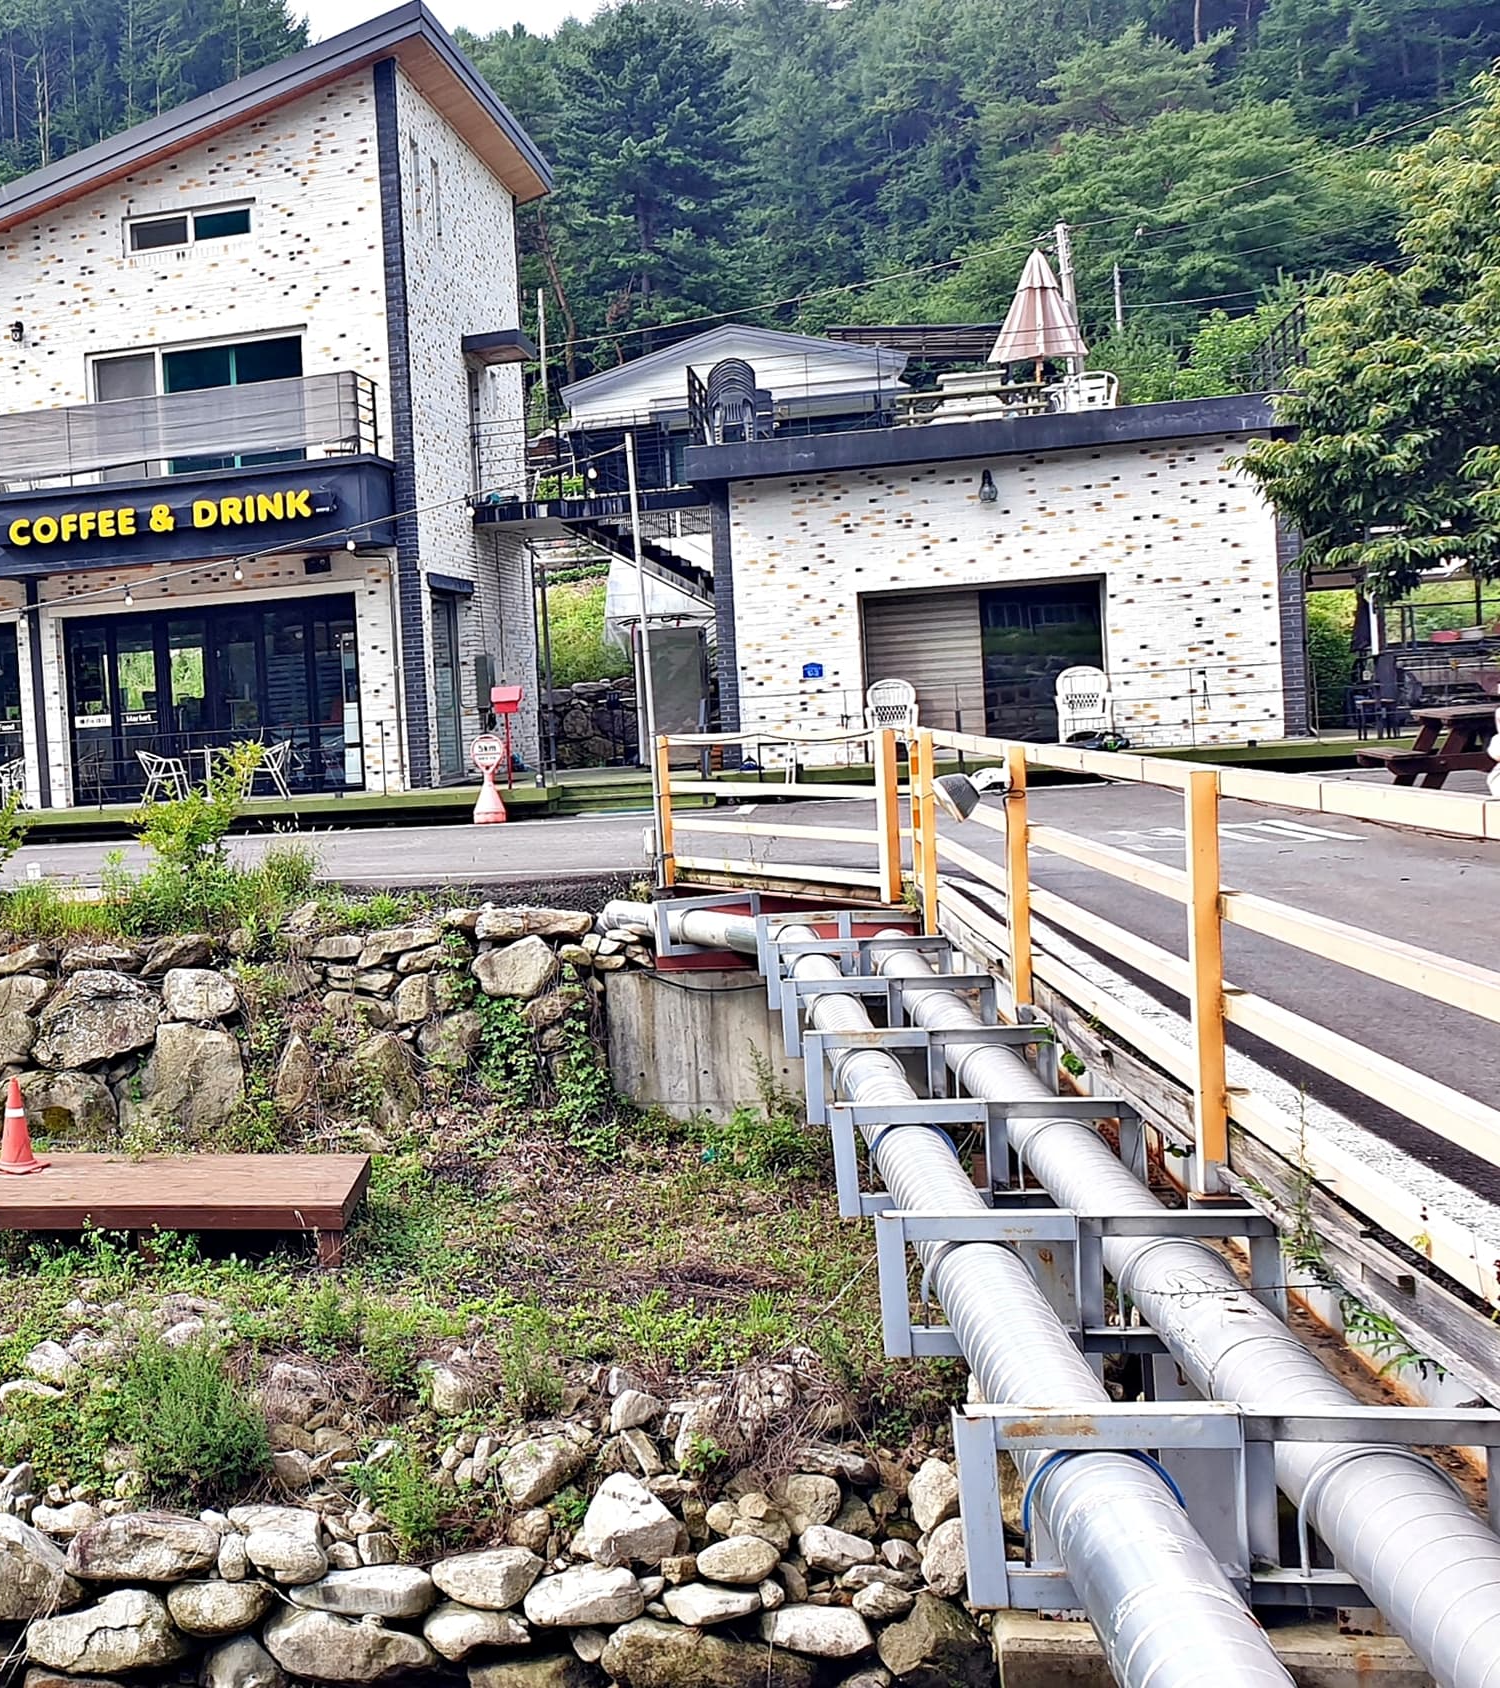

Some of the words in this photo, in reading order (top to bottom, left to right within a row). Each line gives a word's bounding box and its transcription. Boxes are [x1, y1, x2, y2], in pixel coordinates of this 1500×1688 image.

[8, 507, 137, 546] COFFEE
[149, 503, 175, 533] &
[191, 489, 312, 528] DRINK
